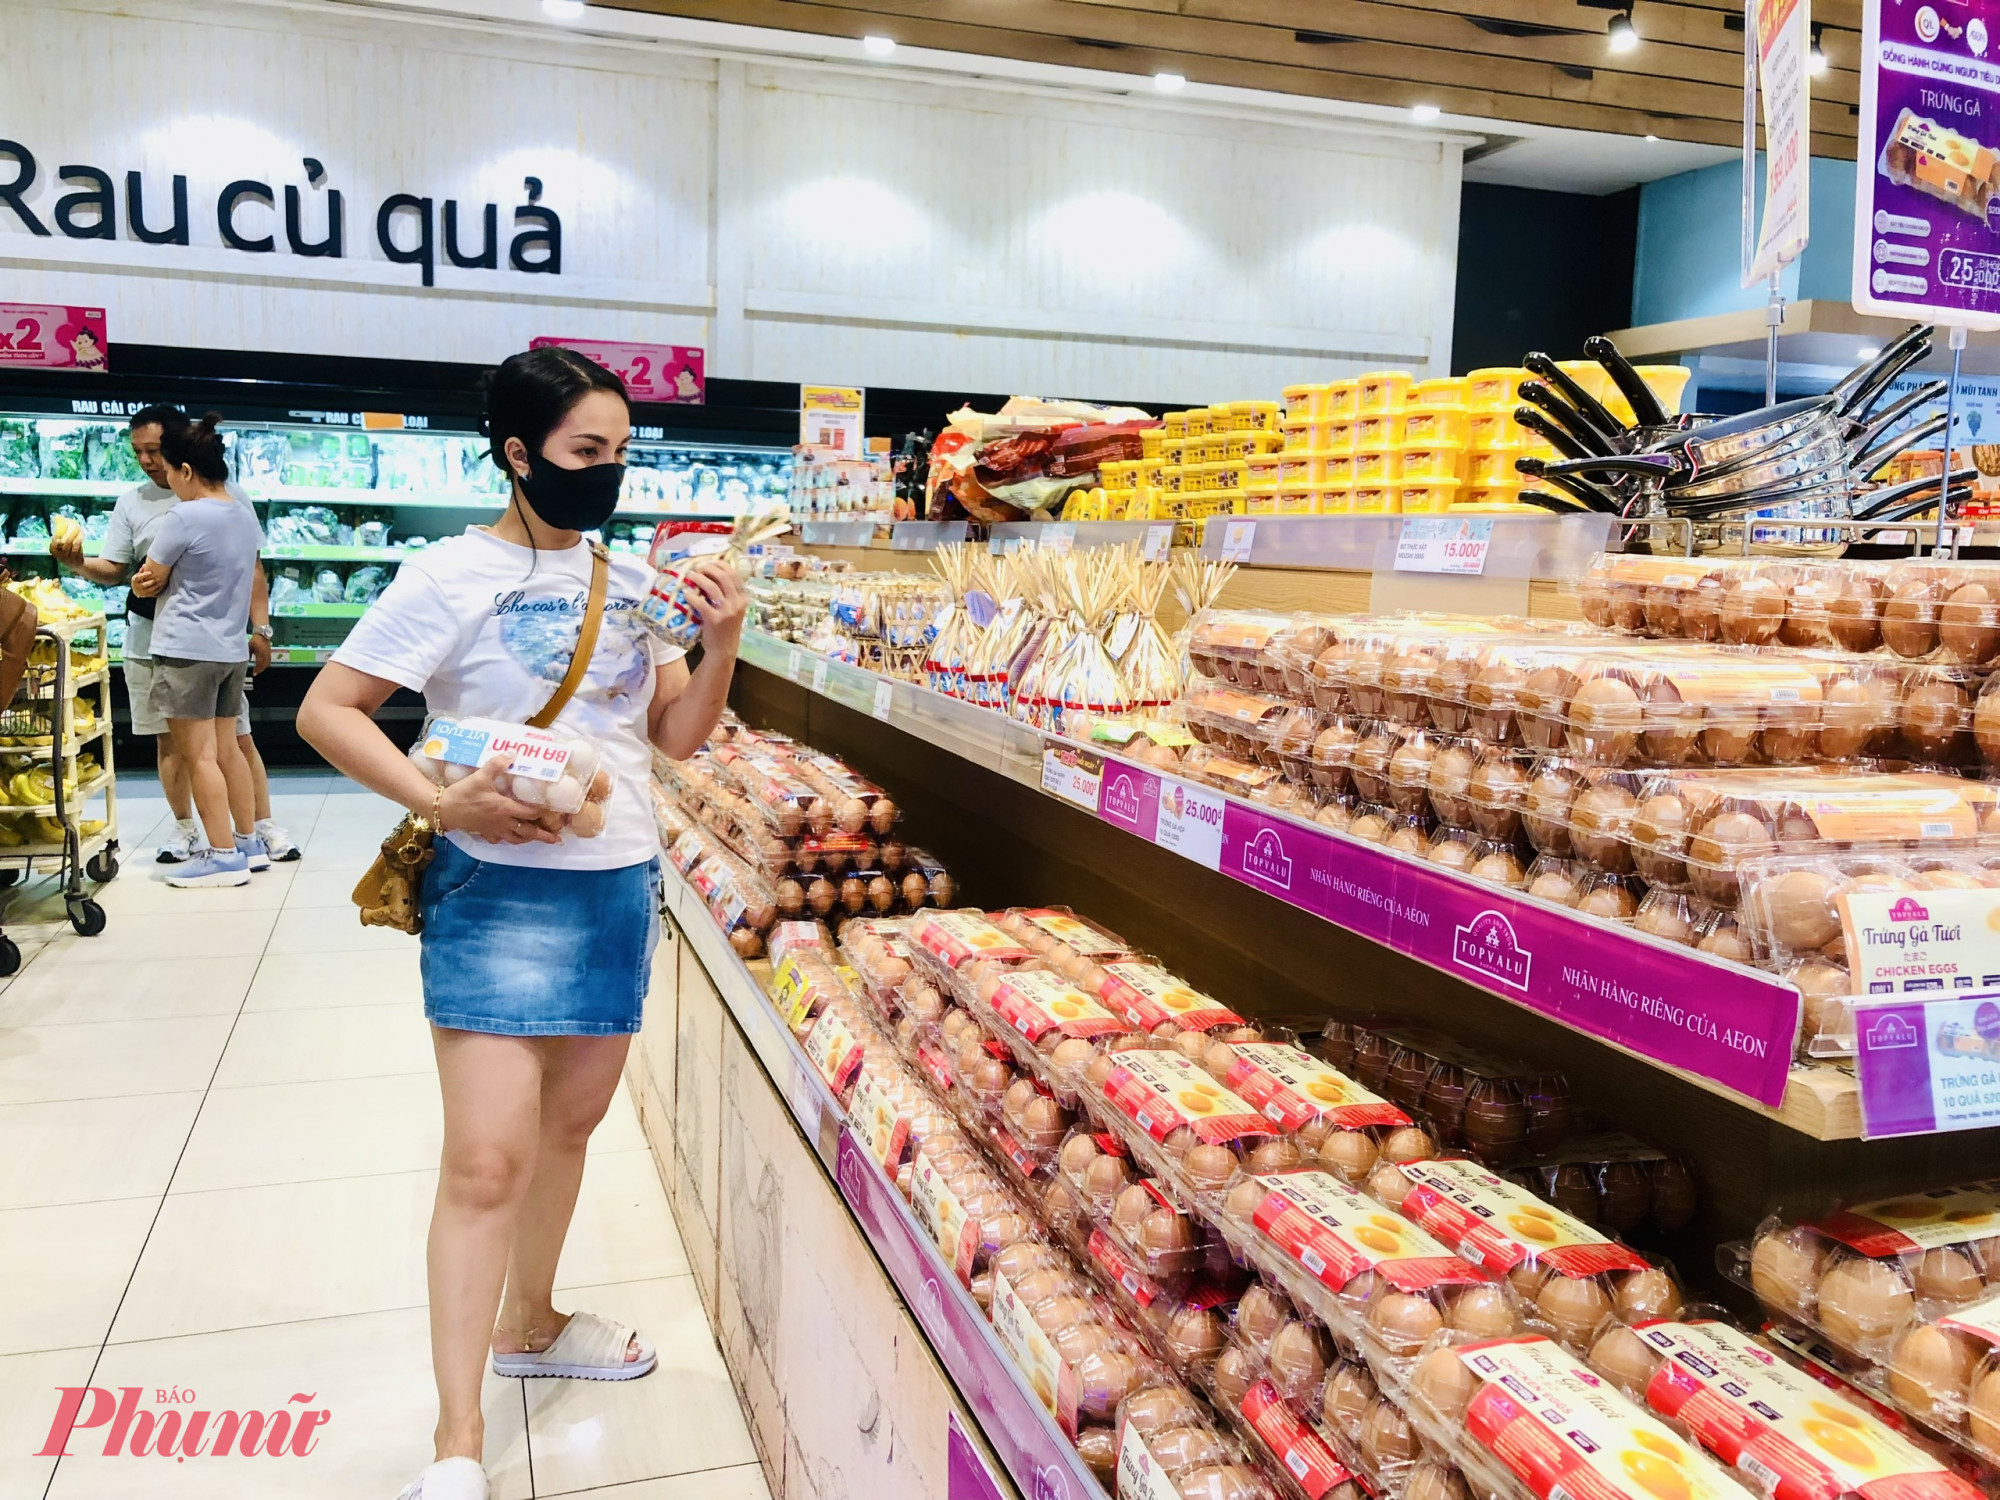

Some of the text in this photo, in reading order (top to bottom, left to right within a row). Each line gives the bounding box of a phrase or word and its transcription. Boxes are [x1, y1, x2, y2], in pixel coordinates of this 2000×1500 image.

[1920, 88, 1981, 117] TRỨNG GÀ
[0, 139, 562, 287] Rau củ quả
[1978, 387, 1998, 397] TANH
[72, 399, 98, 414] RAU
[326, 411, 349, 425] RAU
[1108, 794, 1136, 814] TOPVALU
[1185, 799, 1222, 827] 25.000đ
[1248, 852, 1287, 878] TOPVALU
[1310, 867, 1430, 927] NHÃN HÀNG RIÊNG CỦA AEON
[1862, 923, 1961, 949] Trứng Gà Tươi
[1461, 939, 1523, 976] TOPVALU
[1875, 963, 1959, 978] CHICKEN EGGS
[1562, 966, 1767, 1059] NHÃN HÀNG RIÊNG CỦA AEON
[1940, 1070, 1997, 1089] TRỨNG GÀ
[1943, 1096, 1956, 1108] 10
[1957, 1091, 1981, 1106] QUẢ
[1499, 1357, 1543, 1392] CHICKEN
